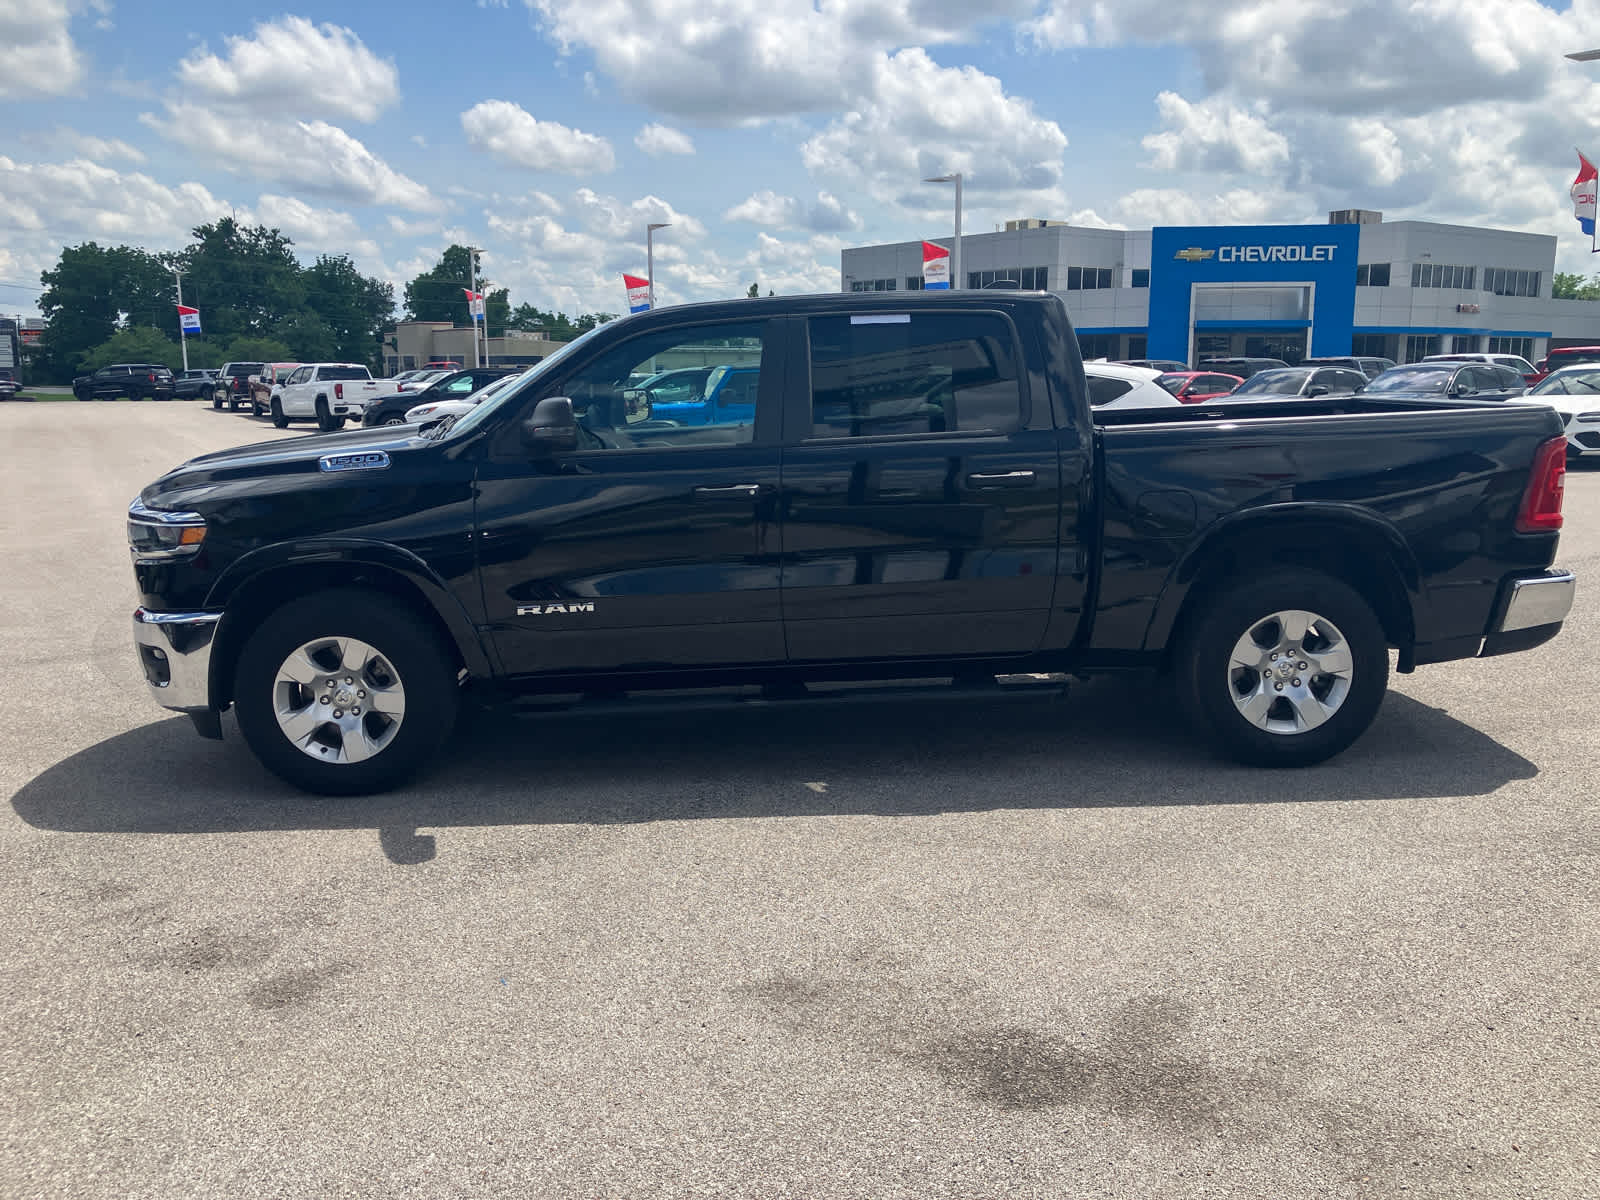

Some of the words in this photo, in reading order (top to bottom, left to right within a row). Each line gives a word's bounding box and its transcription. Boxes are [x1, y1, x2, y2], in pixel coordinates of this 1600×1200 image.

[1218, 245, 1338, 262] CHEVROLET
[330, 455, 380, 465] 1500
[517, 602, 595, 616] RAM
